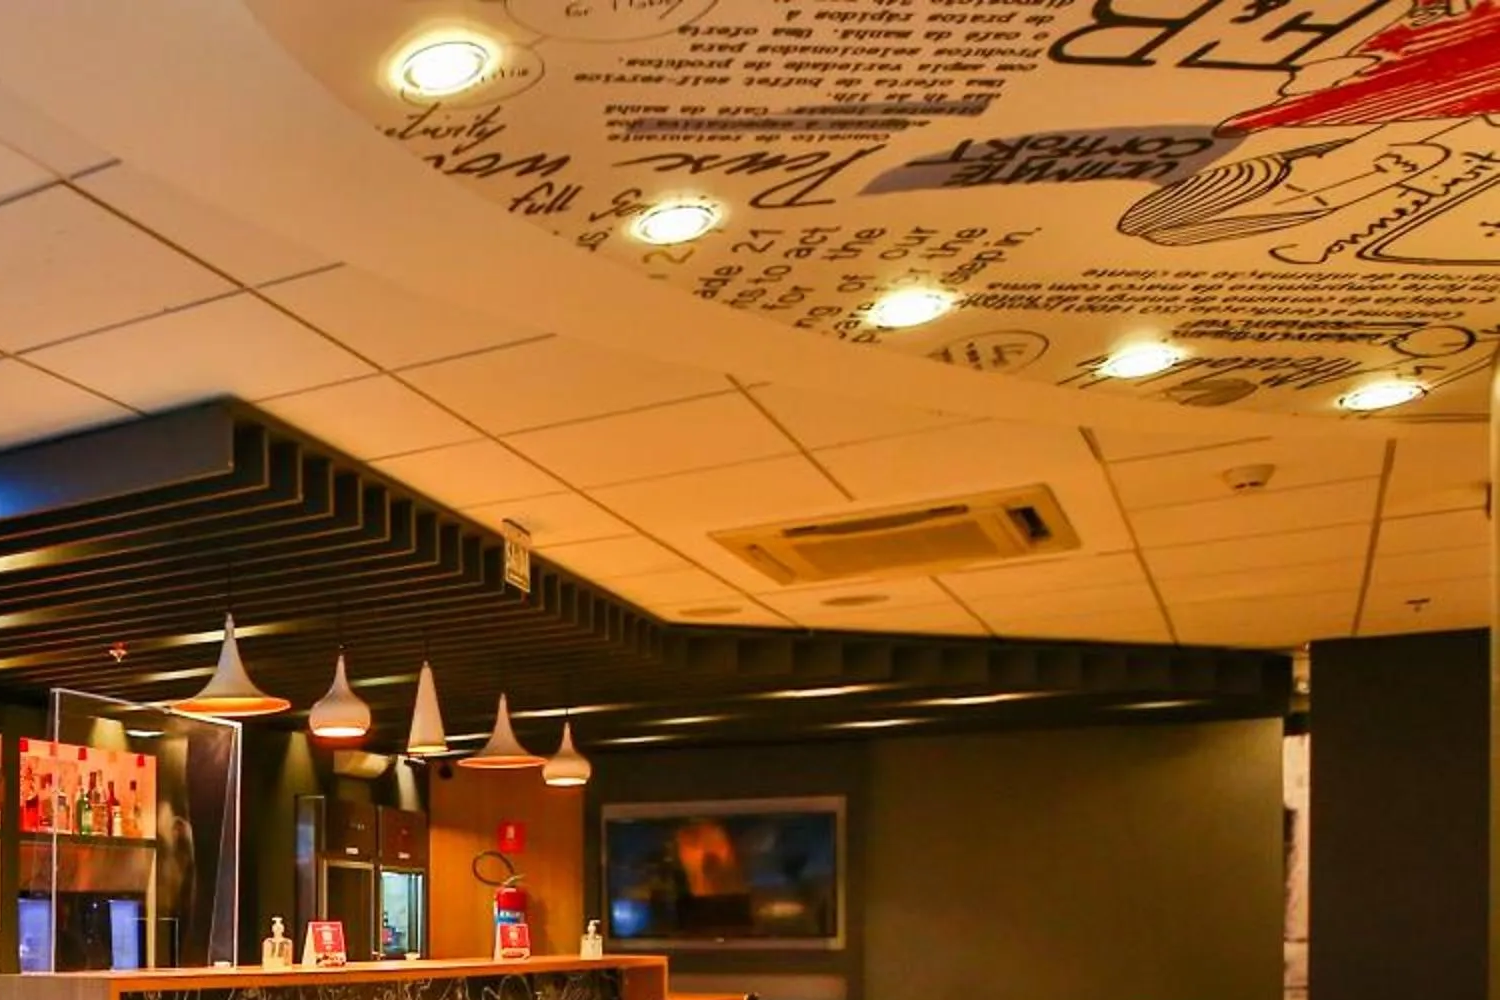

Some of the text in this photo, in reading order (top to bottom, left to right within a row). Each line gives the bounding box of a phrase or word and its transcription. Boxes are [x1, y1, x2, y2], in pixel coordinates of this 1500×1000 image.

[815, 10, 913, 24] rápidos
[927, 12, 1018, 25] pratos
[1025, 15, 1055, 27] de
[678, 25, 1050, 42] o café da manhã. Uma oferta
[689, 43, 1043, 58] Produtos selecionados para
[618, 57, 1038, 73] com ampla variedade de produtos.
[574, 74, 1006, 89] Uma oferta de buffet self-service
[962, 93, 1001, 102] das
[605, 105, 669, 115] manhã
[680, 106, 706, 115] da
[718, 106, 768, 115] Café
[607, 134, 890, 143] Conceito de restaurante
[905, 136, 1214, 168] COMFORT
[612, 144, 886, 209] Pause
[942, 158, 1180, 187] ULTIMATE
[508, 181, 584, 216] full
[731, 227, 785, 254] 21
[982, 226, 1043, 249] in.
[918, 228, 988, 264] the
[747, 264, 792, 285] to
[783, 225, 842, 260] act
[835, 273, 877, 294] of
[878, 225, 939, 261] our
[760, 228, 887, 312] for the
[987, 282, 1043, 292] uma
[1047, 282, 1102, 292] com
